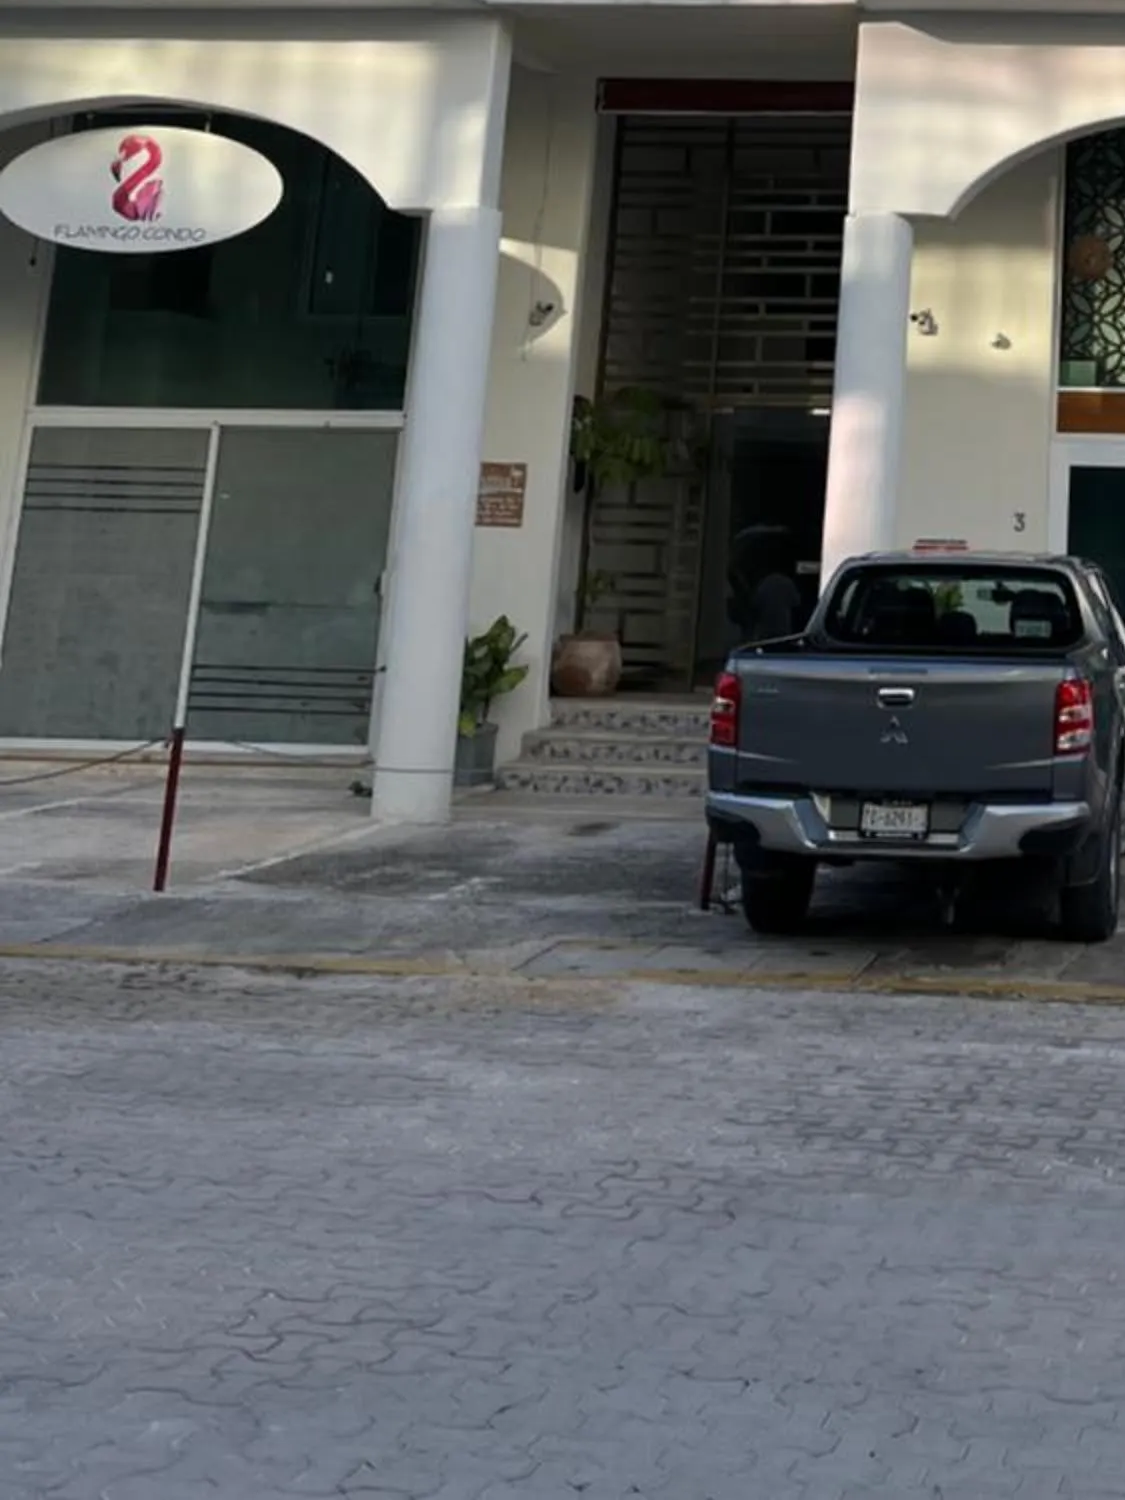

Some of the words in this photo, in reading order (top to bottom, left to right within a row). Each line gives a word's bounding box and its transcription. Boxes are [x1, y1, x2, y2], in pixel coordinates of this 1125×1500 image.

[54, 224, 141, 241] FLAMINGO
[142, 226, 207, 242] CONDO
[1013, 512, 1025, 532] 3
